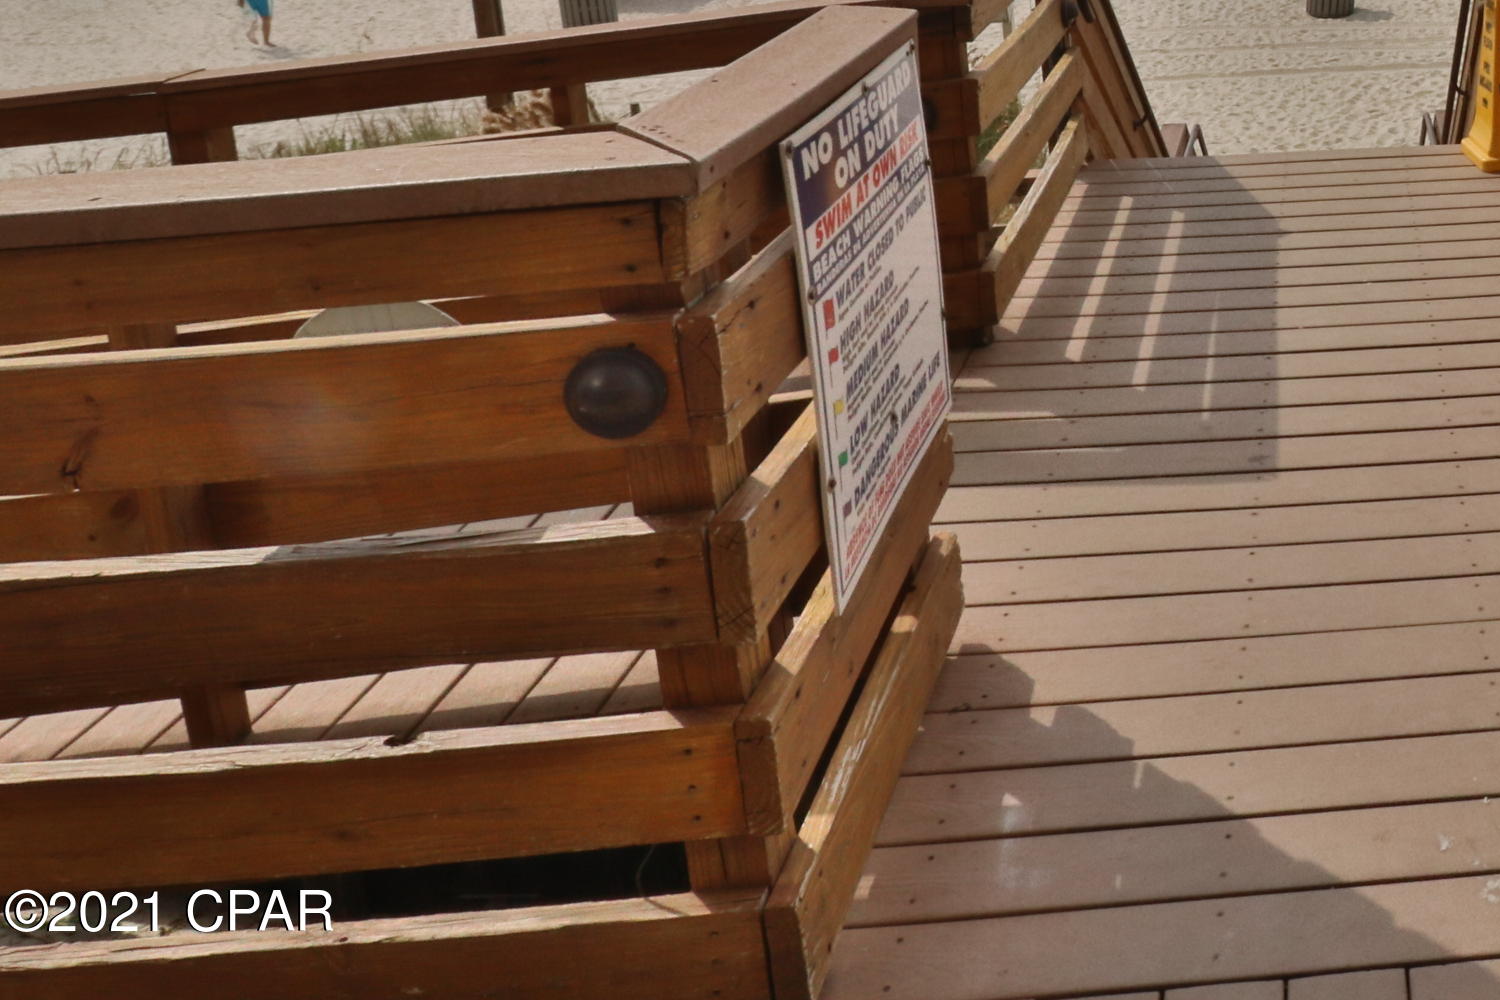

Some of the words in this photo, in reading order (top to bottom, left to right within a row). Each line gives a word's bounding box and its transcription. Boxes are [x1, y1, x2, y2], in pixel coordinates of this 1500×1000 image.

[800, 127, 834, 182] NO
[837, 61, 912, 147] LIFEGUARD
[833, 141, 861, 191] ON
[863, 104, 900, 161] DUTY
[812, 228, 851, 284] BEACH
[852, 175, 899, 237] WARNING
[900, 146, 924, 183] FLAGS
[813, 191, 853, 249] SWIM
[854, 171, 871, 207] AT
[871, 144, 897, 188] OWN
[835, 260, 865, 309] WATER
[866, 226, 894, 270] CLOSED
[895, 212, 904, 236] TO
[839, 311, 862, 353] HIGH
[863, 269, 894, 321] HAZARD
[844, 342, 878, 400] MEDIUM
[880, 297, 909, 350] HAZARD
[848, 410, 869, 454] LOW
[869, 363, 900, 420] HAZARD
[853, 420, 899, 505] DANGEROUS
[899, 372, 927, 428] MARINE
[927, 348, 940, 382] LIFE
